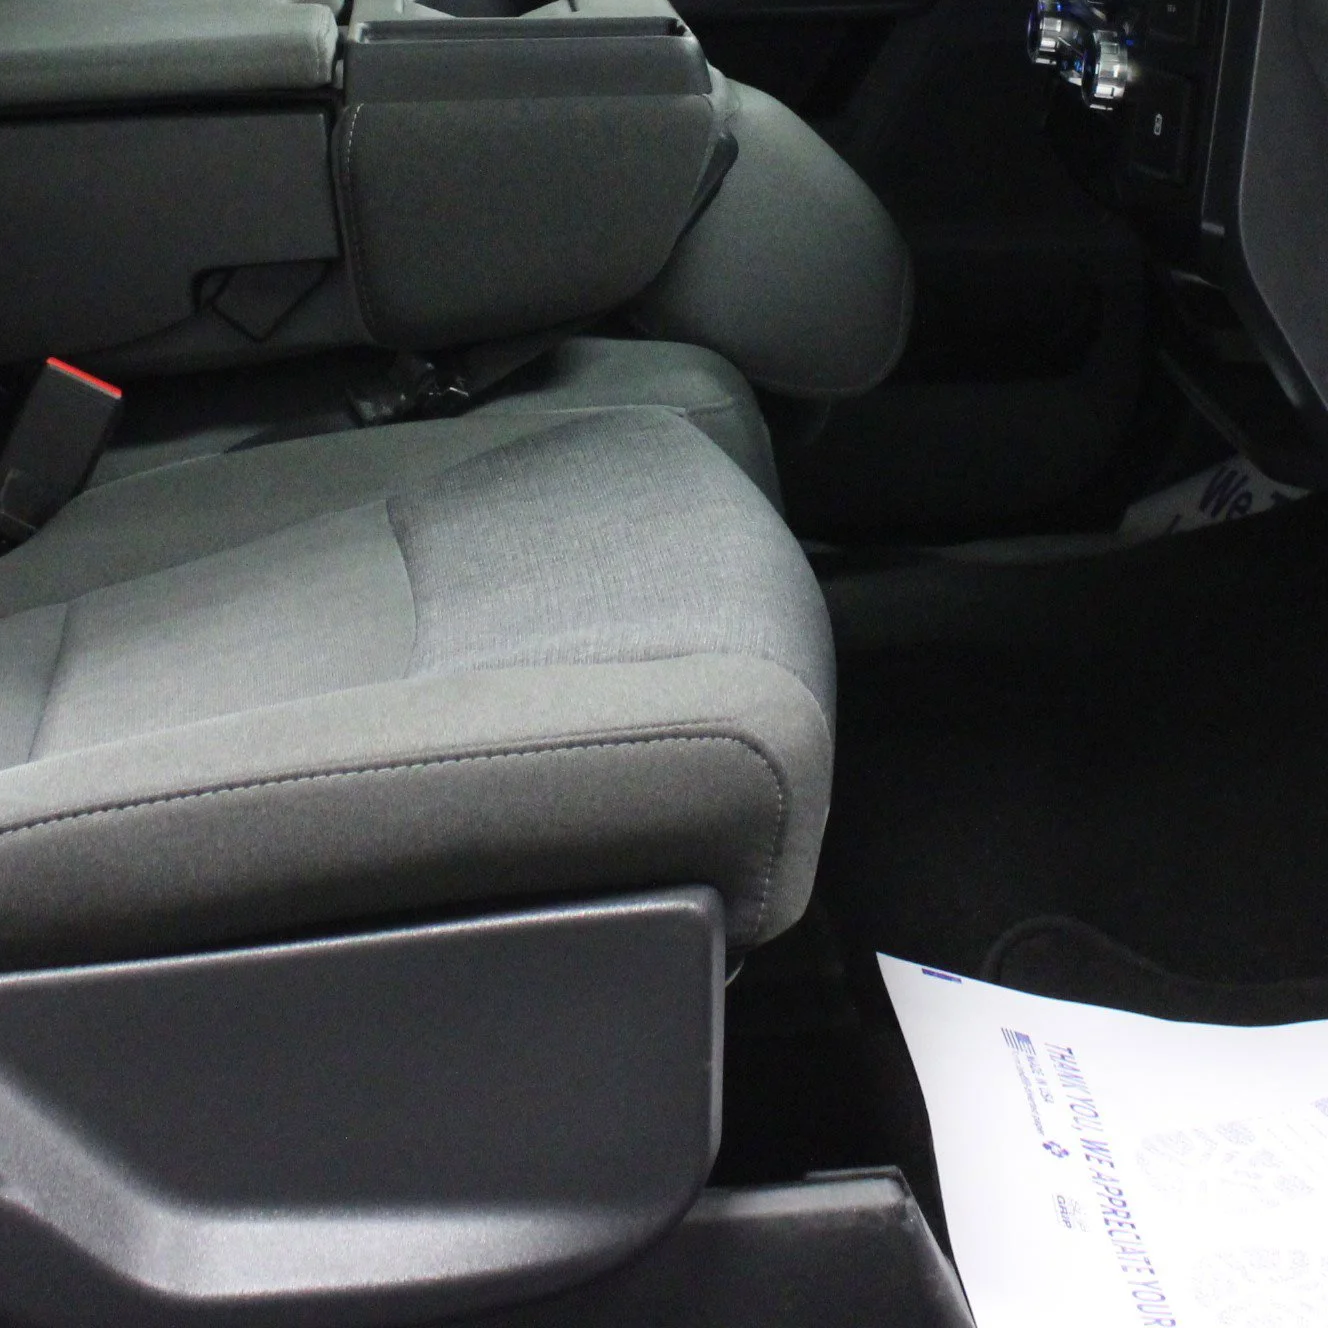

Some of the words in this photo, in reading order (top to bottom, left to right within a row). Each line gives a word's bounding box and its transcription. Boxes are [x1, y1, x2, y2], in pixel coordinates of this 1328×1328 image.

[1044, 1042, 1091, 1095] THANK
[1079, 1137, 1115, 1169] WE
[1088, 1167, 1155, 1275] APPRECIATE
[1127, 1280, 1176, 1327] YOUR
